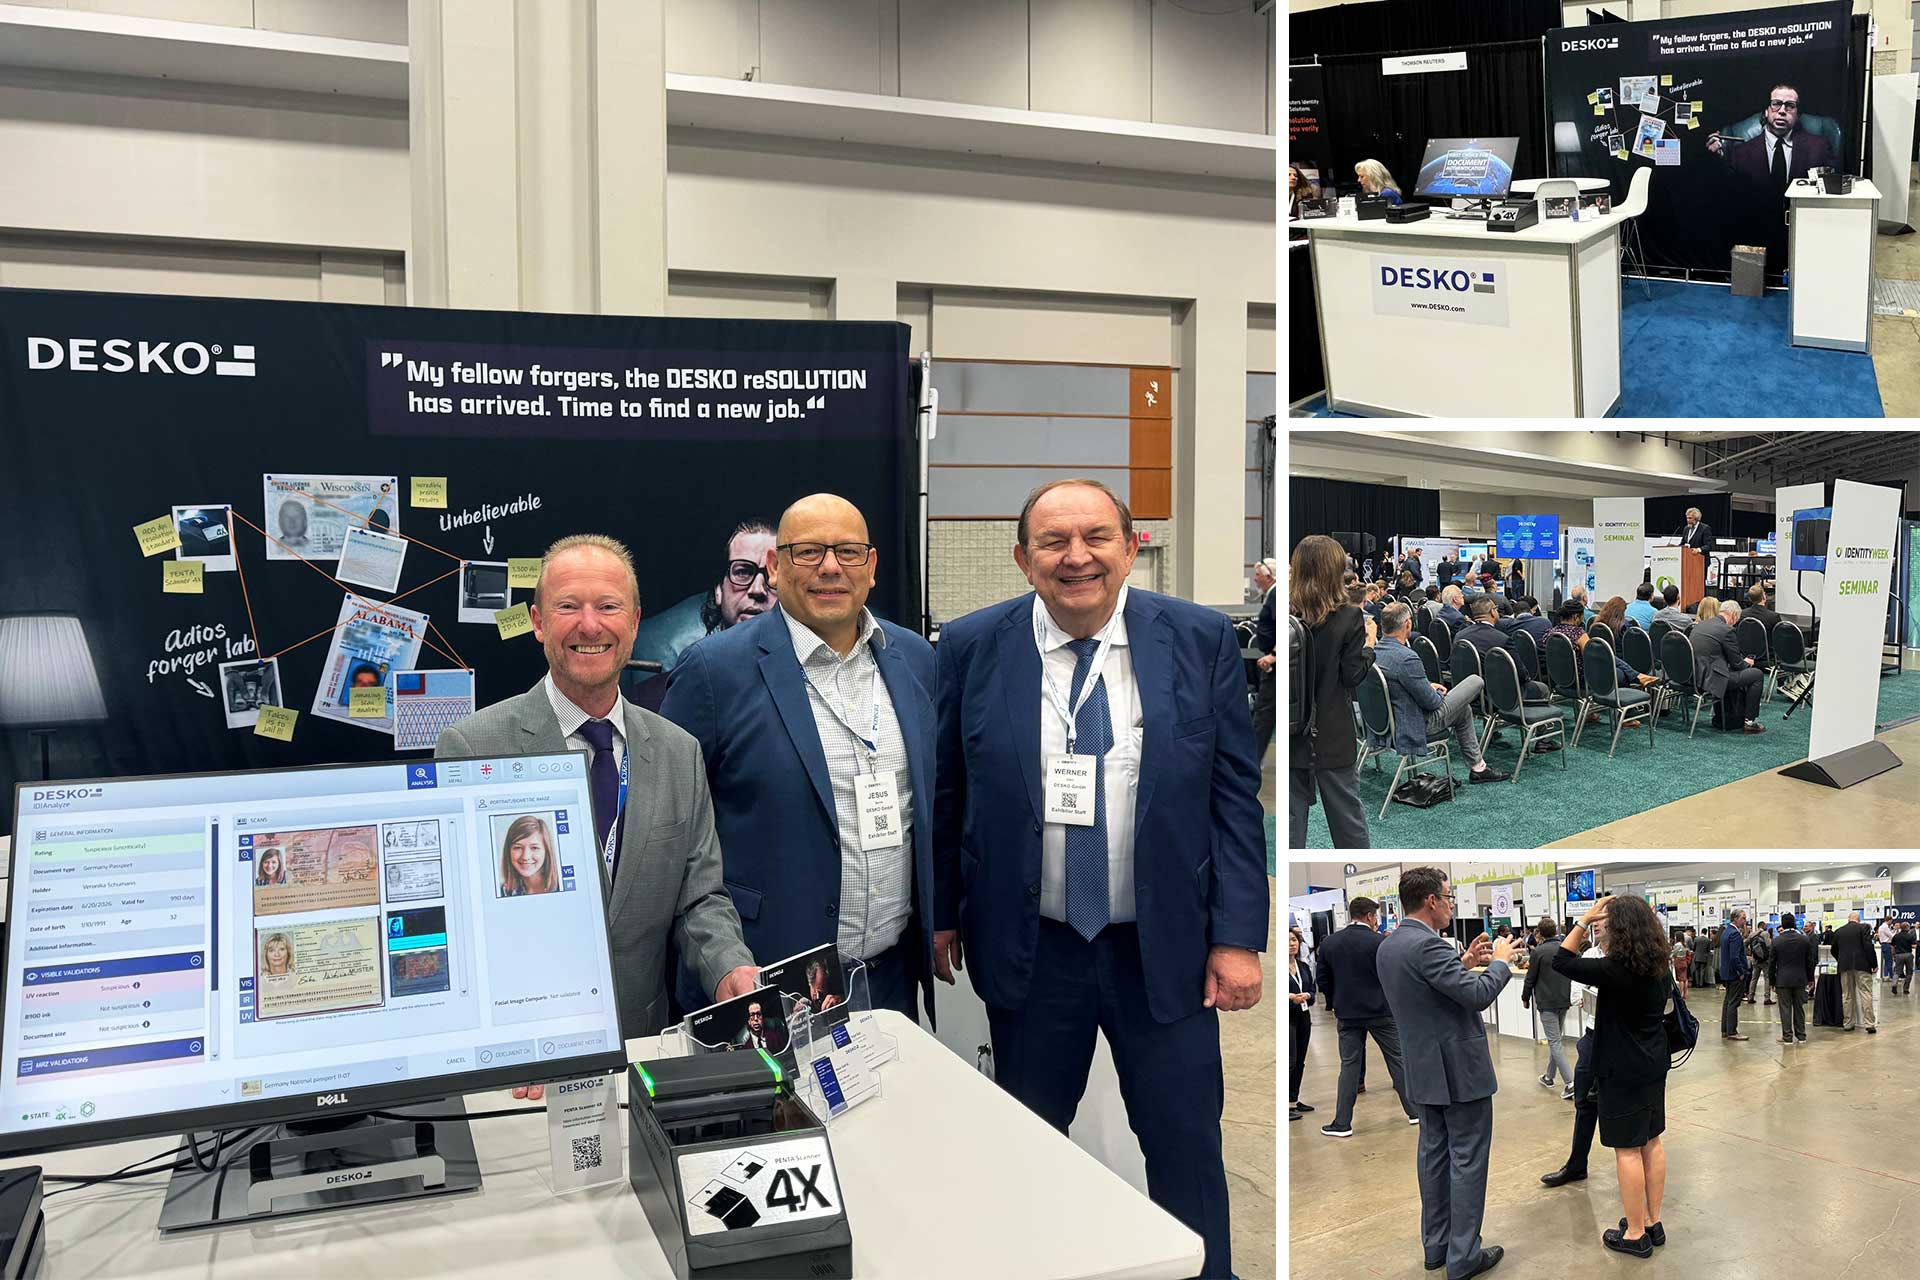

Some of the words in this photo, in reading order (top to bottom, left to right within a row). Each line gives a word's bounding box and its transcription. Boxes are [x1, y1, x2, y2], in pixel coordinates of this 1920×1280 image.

[1674, 34, 1698, 43] fellow
[1699, 33, 1731, 43] forgers,
[1732, 30, 1747, 39] the
[1748, 27, 1776, 37] DESKO
[1778, 20, 1832, 35] reSOLUTION
[1660, 46, 1675, 55] has
[1676, 43, 1707, 54] arrived.
[1708, 42, 1729, 51] Time
[1730, 41, 1740, 50] to
[1741, 40, 1758, 49] find
[1759, 40, 1766, 48] a
[1767, 39, 1786, 47] new
[1503, 212, 1516, 220] 4X
[1410, 303, 1466, 313] www.DESKO.com
[451, 361, 523, 386] fellow
[530, 364, 619, 391] forgers,
[625, 367, 660, 388] the
[666, 368, 737, 389] DESKO
[743, 369, 867, 391] reSOLUTION
[408, 391, 453, 414] has
[460, 393, 551, 417] arrived.
[558, 396, 612, 418] Time
[620, 397, 642, 418] to
[649, 397, 690, 418] find
[697, 402, 711, 418] a
[717, 403, 761, 419] new
[439, 493, 543, 531] Unbelievable
[1603, 534, 1635, 542] SEMINAR
[1845, 548, 1889, 559] IDENTITYWEEK
[1839, 580, 1879, 595] SEMINAR
[355, 609, 414, 639] ALABAMA
[165, 623, 226, 652] Adios
[146, 647, 218, 683] forger
[225, 633, 255, 659] lab
[266, 709, 289, 721] Takes
[277, 719, 286, 727] to
[1054, 768, 1088, 777] WERNER
[33, 788, 89, 801] DESKO
[867, 790, 888, 799] JESUS
[1051, 807, 1074, 815] Exhibitor
[49, 830, 76, 838] GENERAL
[76, 828, 114, 836] INFORMATION
[868, 832, 887, 840] Exhibitor
[33, 868, 62, 876] Document
[83, 864, 109, 873] Germany
[109, 862, 133, 870] Passport
[31, 905, 62, 914] Expiration
[51, 923, 66, 931] birth
[120, 918, 132, 926] Age
[29, 943, 58, 951] Additional
[40, 970, 62, 979] VISIBLE
[63, 966, 101, 976] VALIDATIONS
[35, 990, 60, 998] reaction
[23, 1032, 54, 1041] Document
[54, 1030, 66, 1038] size
[558, 1041, 585, 1050] DOCUMENT
[495, 1049, 523, 1058] DOCUMENT
[35, 1060, 49, 1068] MRZ
[49, 1056, 88, 1067] VALIDATIONS
[446, 1057, 467, 1065] CANCEL
[264, 1080, 290, 1089] Germany
[290, 1076, 312, 1085] National
[312, 1074, 337, 1084] passport
[559, 1079, 595, 1093] DESKO
[317, 1093, 348, 1106] DELL
[774, 1156, 795, 1164] PENTA
[796, 1153, 821, 1162] Scanner
[326, 1172, 363, 1184] DESKO
[766, 1163, 832, 1213] 4X
